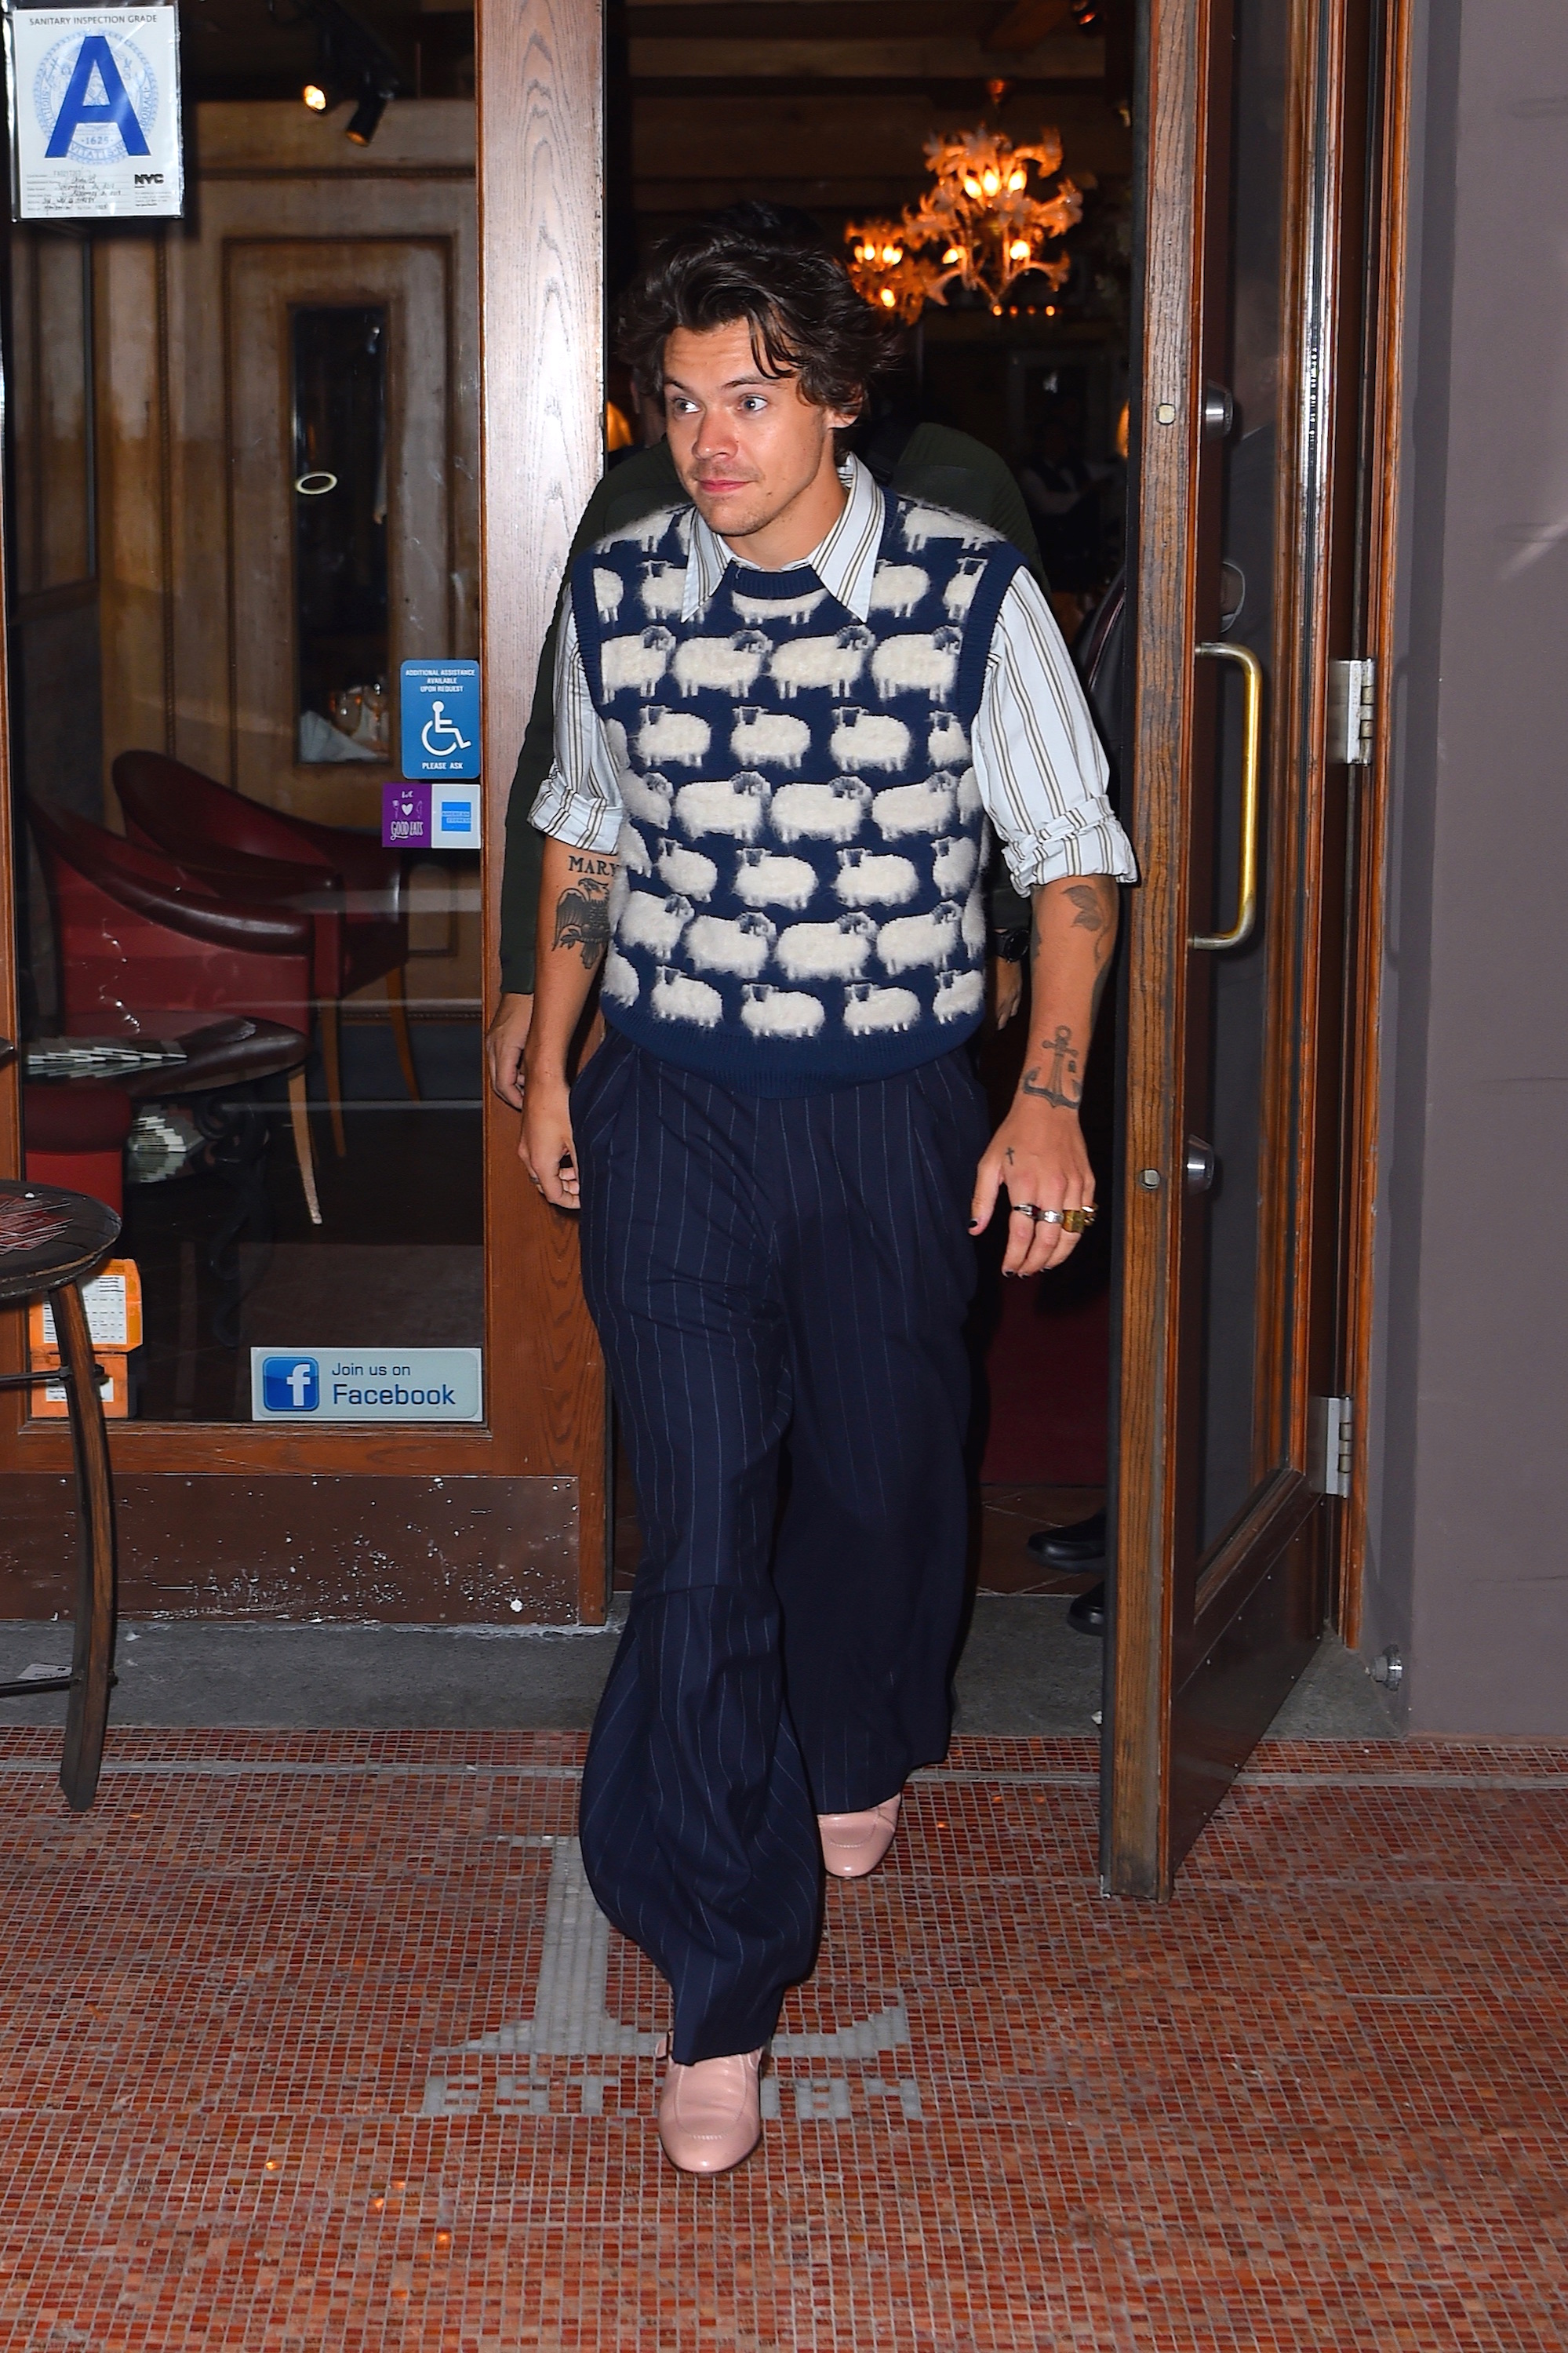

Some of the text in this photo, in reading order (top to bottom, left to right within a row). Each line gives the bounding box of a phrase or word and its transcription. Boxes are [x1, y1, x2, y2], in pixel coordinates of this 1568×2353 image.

[73, 16, 126, 24] INSPECTION
[127, 14, 158, 24] GRADE
[45, 35, 151, 158] A
[134, 173, 164, 184] NYC
[390, 821, 424, 841] GOOD EATS
[332, 1362, 410, 1376] Join us on
[333, 1384, 456, 1406] Facebook
